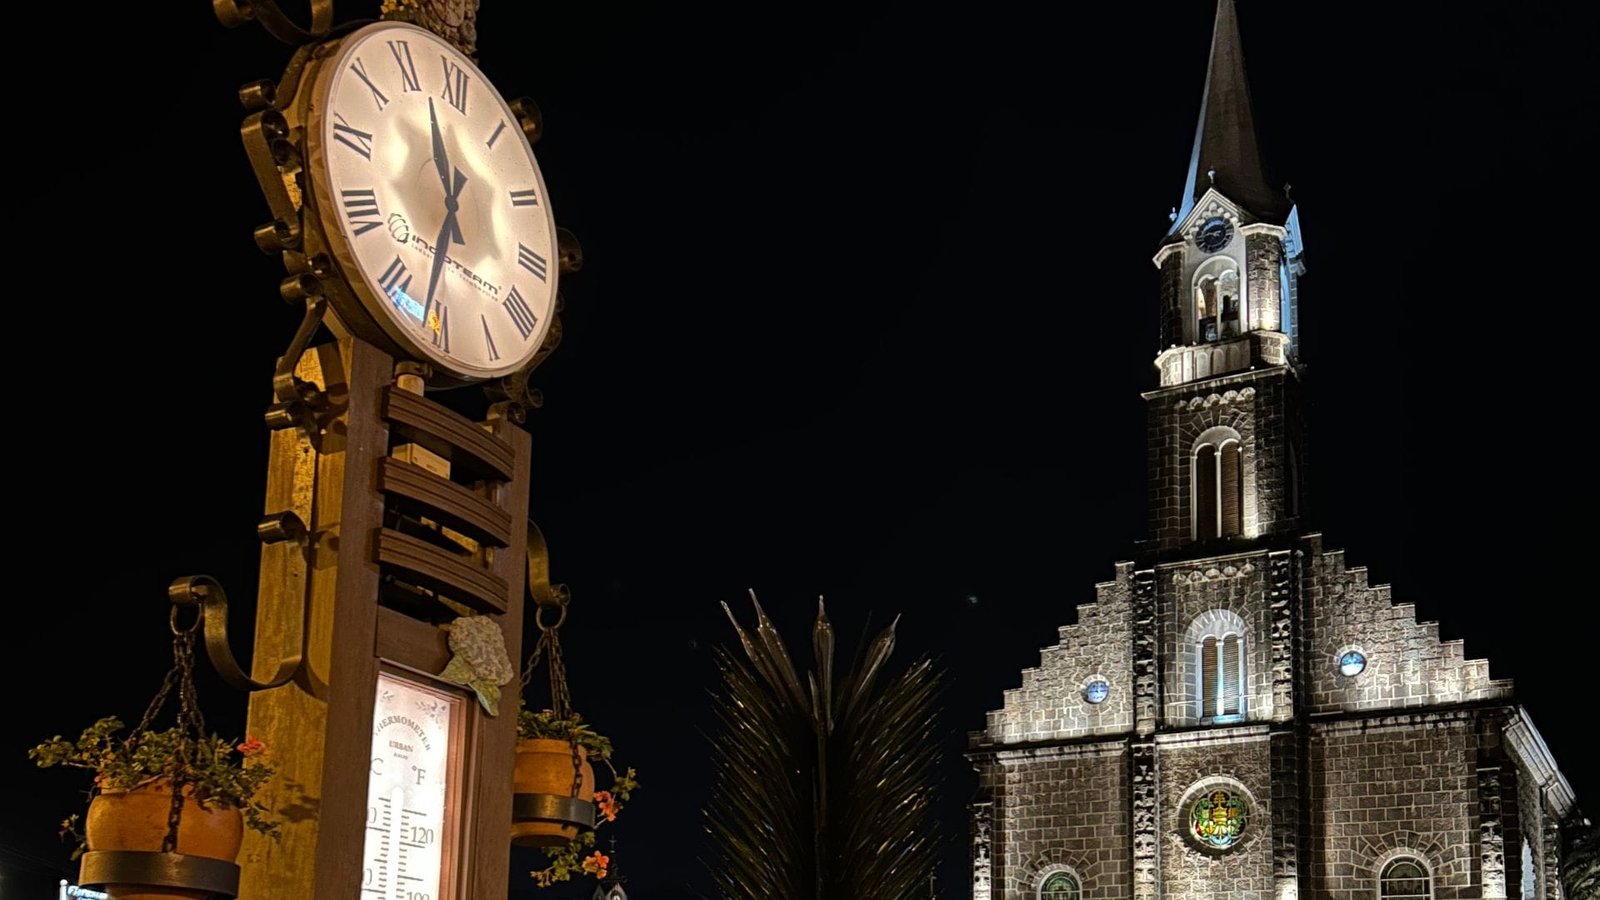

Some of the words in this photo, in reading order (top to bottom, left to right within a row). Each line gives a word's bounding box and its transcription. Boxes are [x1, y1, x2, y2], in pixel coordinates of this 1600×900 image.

[351, 57, 390, 111] X
[387, 40, 422, 92] XI
[440, 55, 470, 116] XII
[334, 113, 373, 161] IX
[486, 119, 506, 149] I
[341, 188, 383, 236] VIII
[510, 189, 538, 207] II
[518, 242, 547, 283] III
[502, 285, 538, 340] IIII
[481, 313, 500, 361] V
[410, 826, 434, 844] 120
